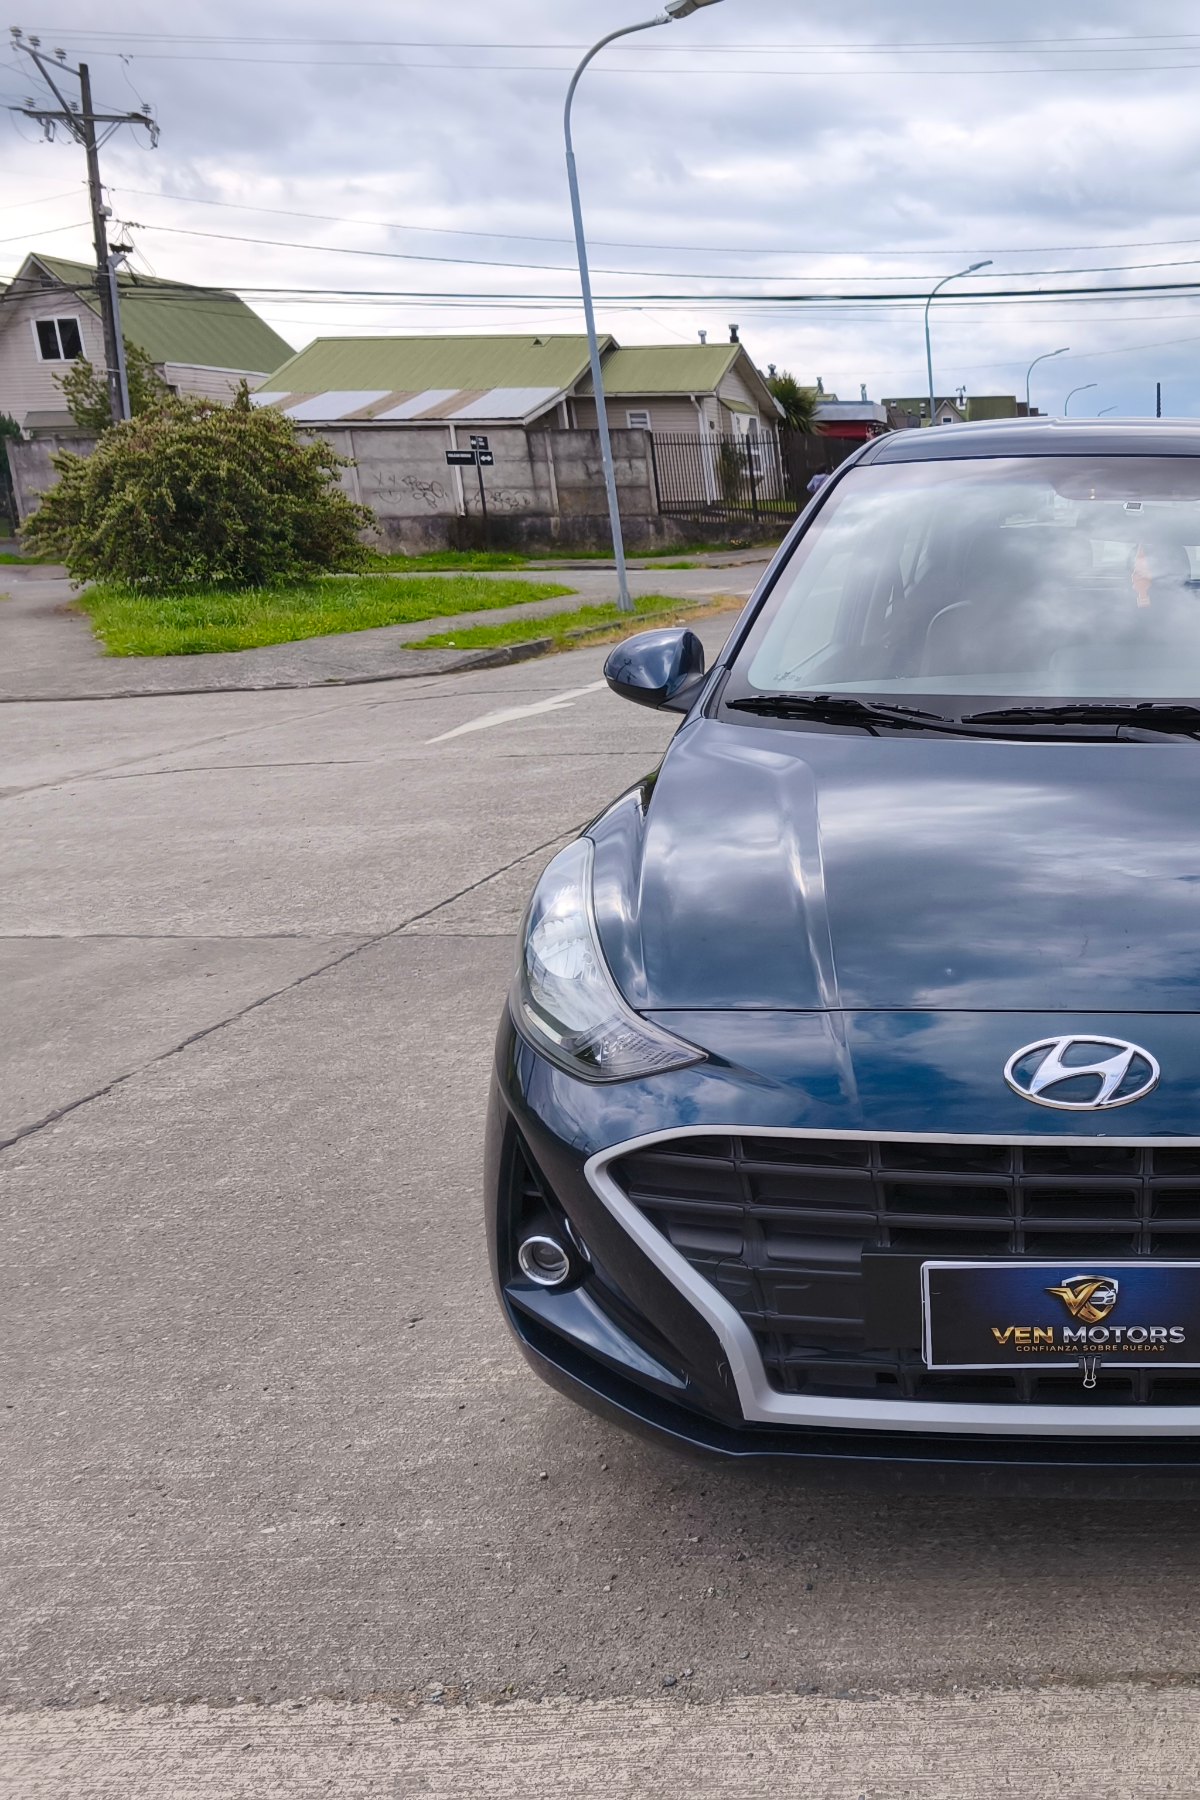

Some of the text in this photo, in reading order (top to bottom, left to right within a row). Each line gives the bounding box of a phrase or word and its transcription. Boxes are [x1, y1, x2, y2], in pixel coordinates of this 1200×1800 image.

[991, 1325, 1186, 1345] VEN MOTORS
[1015, 1344, 1166, 1352] CONFIANZA SOBRE RUEDAS
